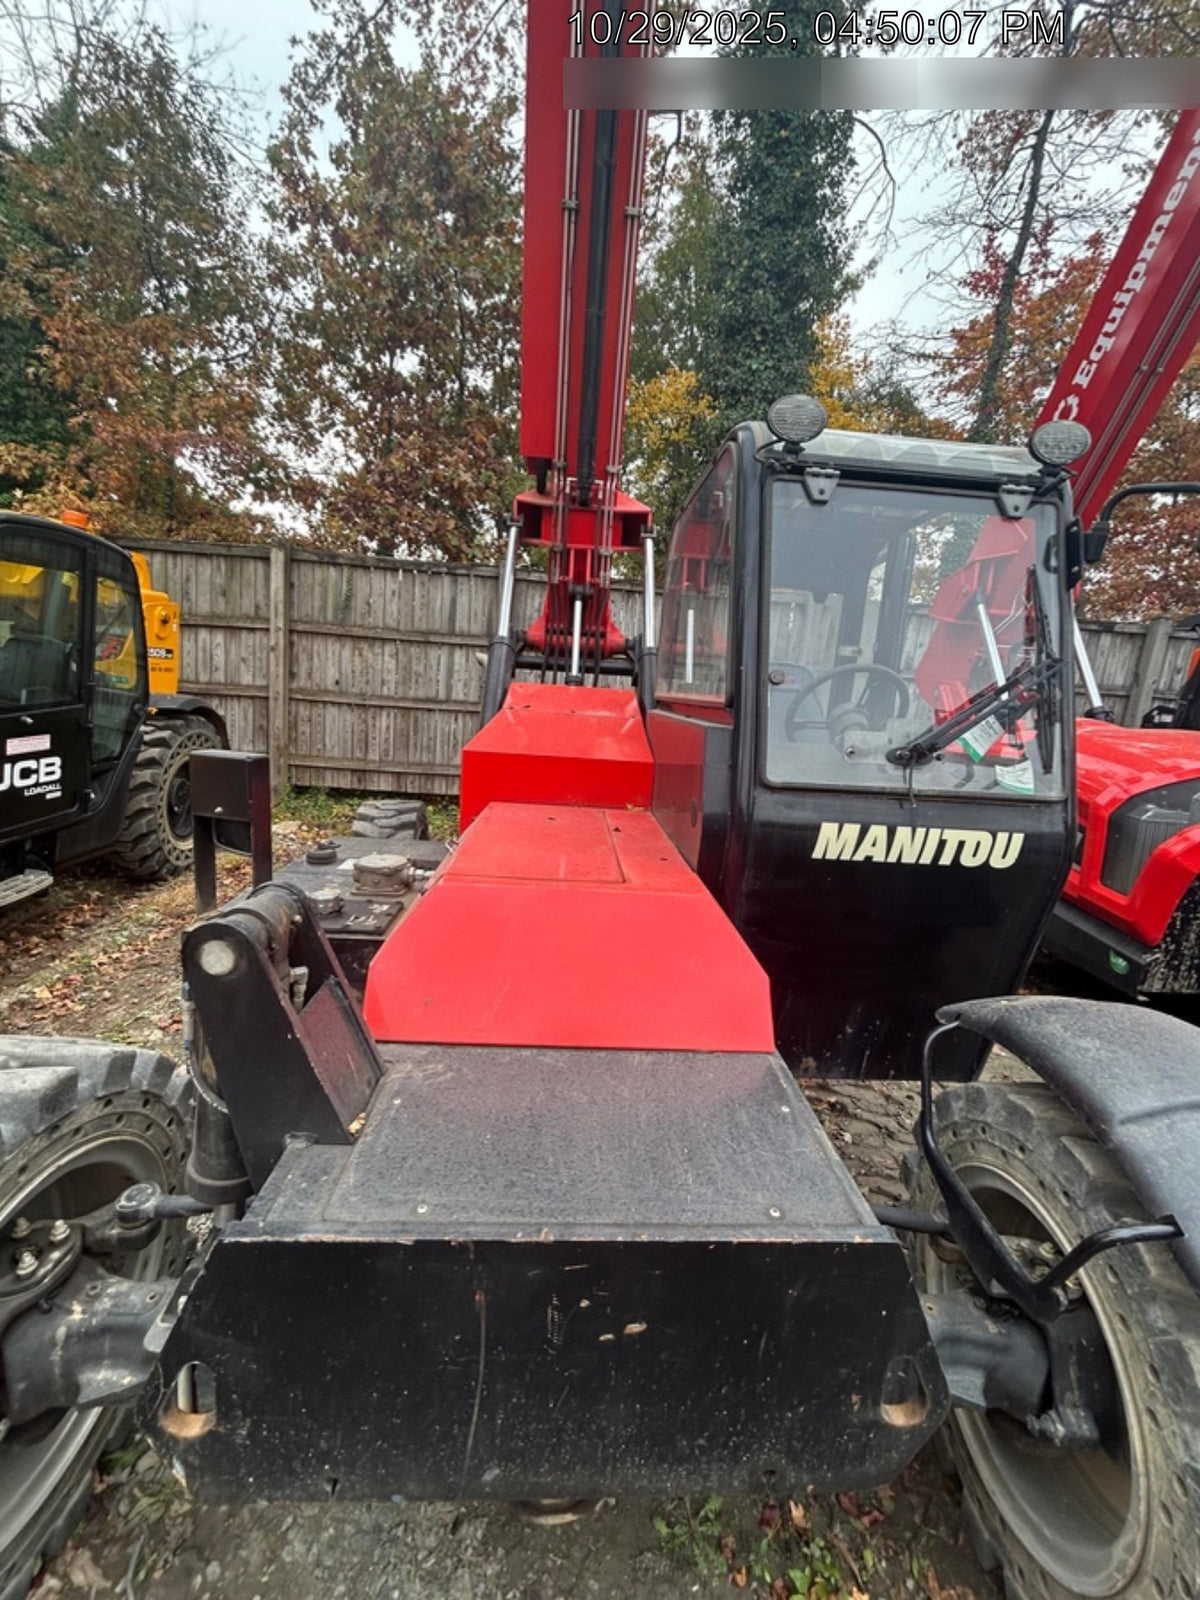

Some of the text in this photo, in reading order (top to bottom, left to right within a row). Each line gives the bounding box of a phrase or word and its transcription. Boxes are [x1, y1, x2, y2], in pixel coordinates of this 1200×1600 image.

[1071, 128, 1200, 389] Equipmen
[0, 756, 62, 791] JCB
[811, 822, 1025, 869] MANITOU
